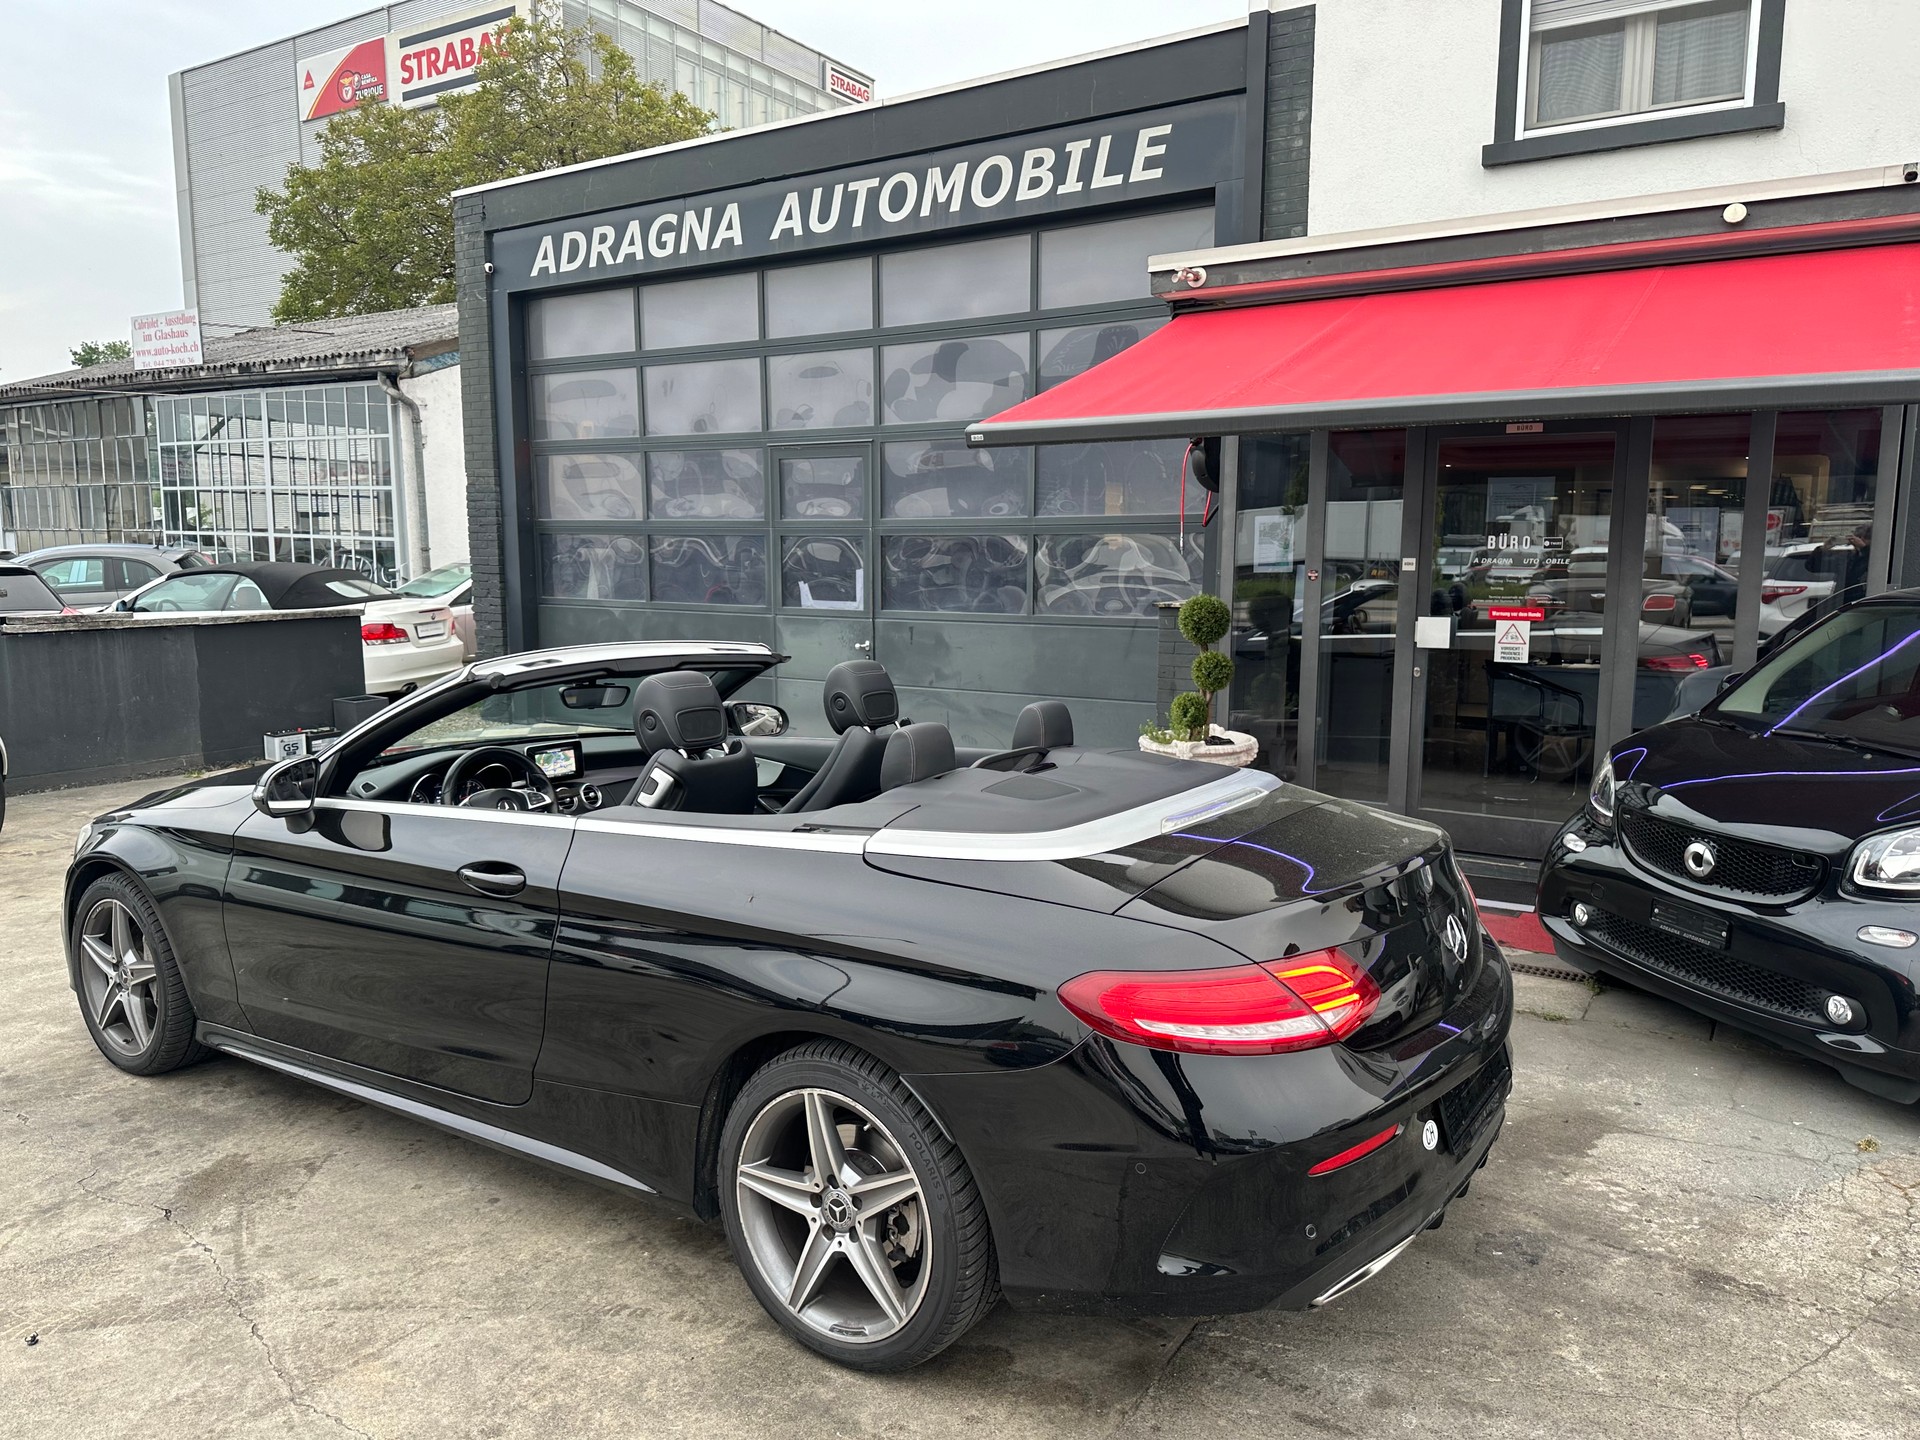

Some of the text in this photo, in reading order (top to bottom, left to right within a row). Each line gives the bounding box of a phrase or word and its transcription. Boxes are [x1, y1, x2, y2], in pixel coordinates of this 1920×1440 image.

[831, 73, 870, 102] STRABAG
[530, 123, 1172, 277] ADRAGNA AUTOMOBILE
[133, 317, 159, 331] Cabriolet
[164, 313, 197, 326] Ausstellung
[142, 328, 189, 342] im Glashaus
[135, 341, 199, 357] www.auto-koch.ch
[1487, 533, 1531, 549] BÜRO
[283, 742, 299, 752] GS
[909, 1132, 945, 1201] POLARIS 5
